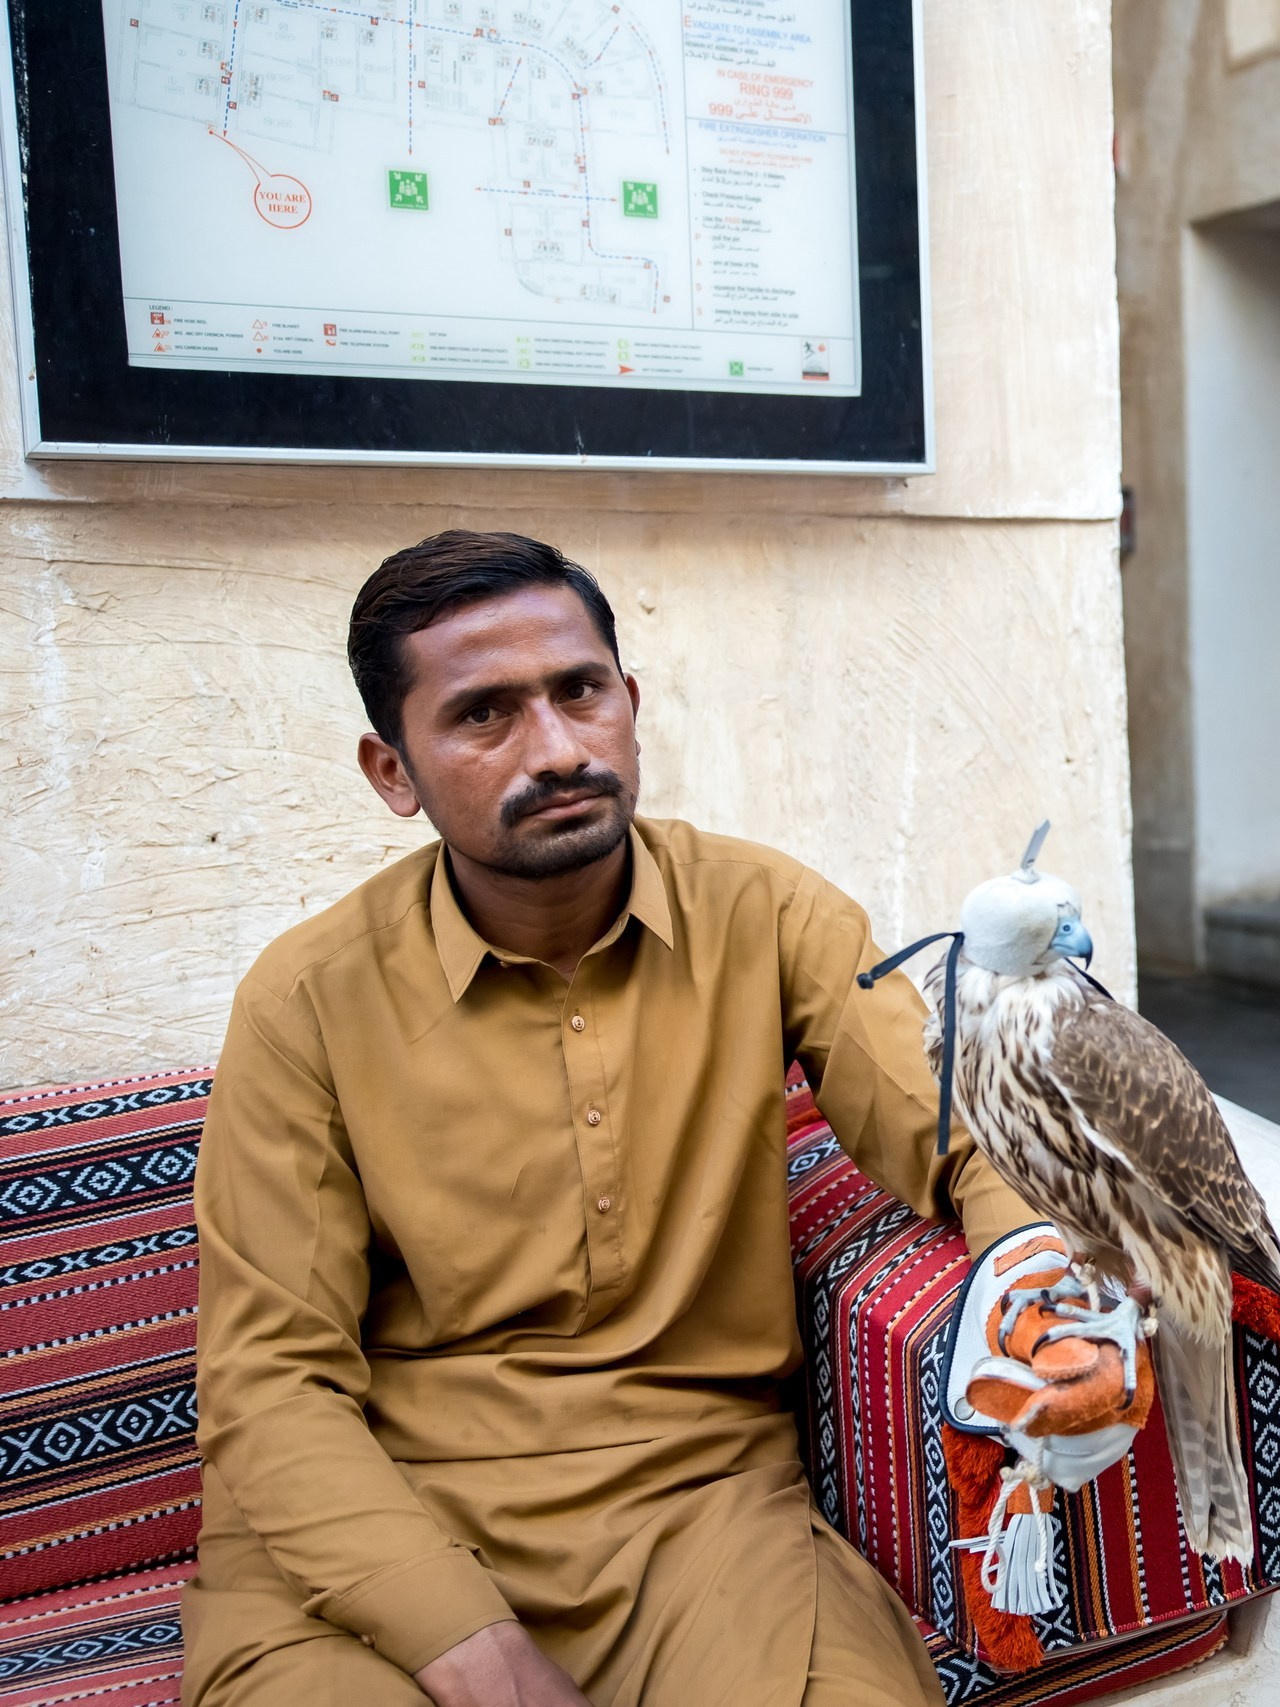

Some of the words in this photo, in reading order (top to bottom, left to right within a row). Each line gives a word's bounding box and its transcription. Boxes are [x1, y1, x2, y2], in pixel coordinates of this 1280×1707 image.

[684, 15, 730, 32] EVACUATE
[733, 24, 744, 34] TO
[746, 26, 788, 40] ASSEMBLY
[790, 33, 811, 43] AREA
[717, 69, 725, 77] IN
[727, 70, 749, 80] CASE
[750, 73, 761, 81] OF
[764, 74, 814, 88] EMERGENCY
[739, 82, 770, 97] RING
[772, 86, 793, 100] 999
[709, 102, 733, 116] 999
[698, 120, 718, 132] FIRE
[719, 123, 779, 137] EXTINGUISHER
[780, 129, 827, 142] OPERATION
[259, 191, 281, 201] YOU
[284, 193, 306, 203] ARE
[269, 204, 298, 214] HERE
